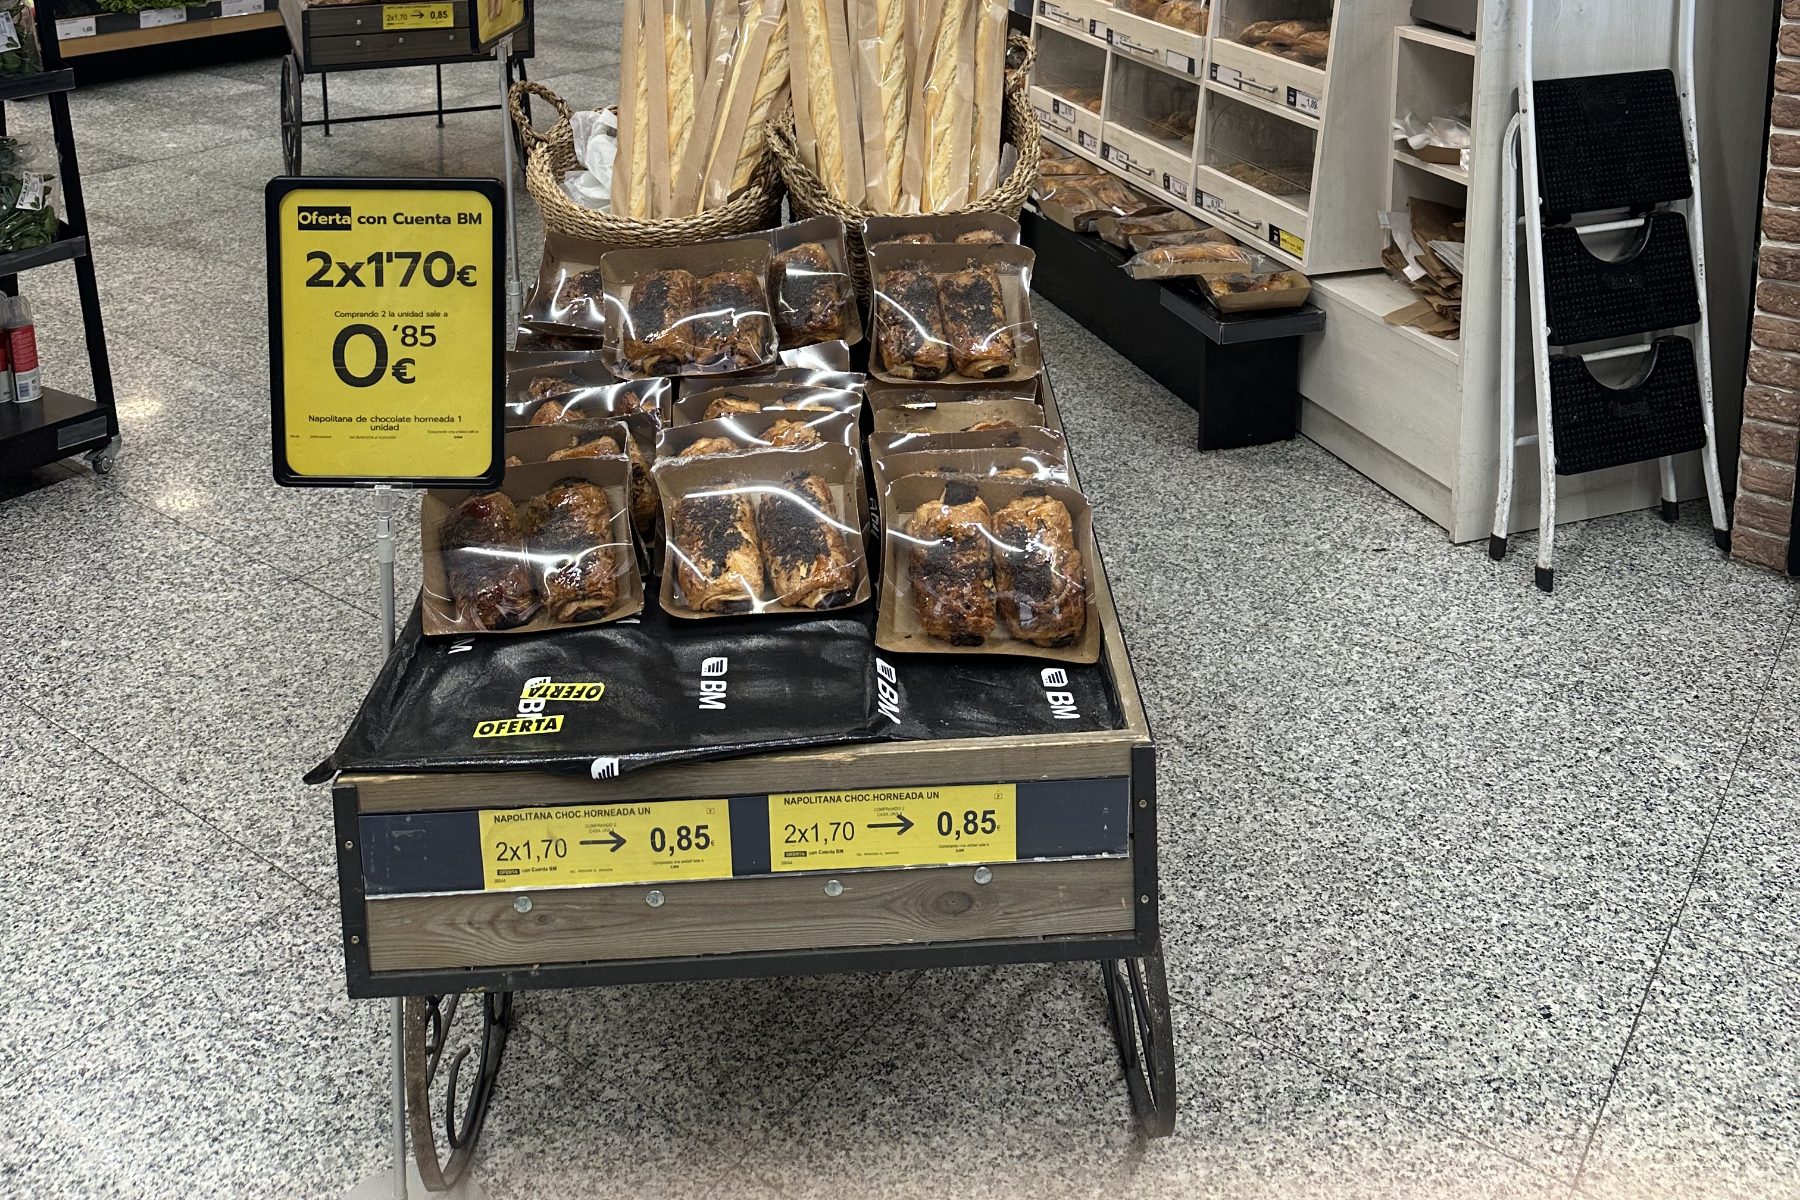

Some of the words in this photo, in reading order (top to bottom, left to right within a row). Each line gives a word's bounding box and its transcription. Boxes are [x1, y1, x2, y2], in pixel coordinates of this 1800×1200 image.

[430, 10, 448, 20] 0,85
[298, 211, 351, 225] Oferta
[357, 214, 387, 225] con
[393, 212, 451, 225] Cuenta
[457, 213, 482, 225] BM
[334, 311, 379, 319] Comprando
[308, 414, 353, 424] Napolitana
[355, 415, 367, 423] de
[370, 415, 411, 423] chocolate
[414, 415, 455, 423] horneada
[458, 415, 462, 423] 1
[527, 685, 602, 700] OFERTA
[699, 680, 727, 710] BM
[877, 676, 901, 725] BM
[1046, 691, 1081, 720] BM
[478, 717, 558, 736] OFERTA
[784, 794, 842, 805] NAPOLITANA
[926, 791, 940, 800] UN
[493, 811, 553, 823] NAPOLITANA
[637, 807, 651, 816] UN
[784, 821, 855, 845] 2x1,70
[495, 838, 568, 862] 2x1,70
